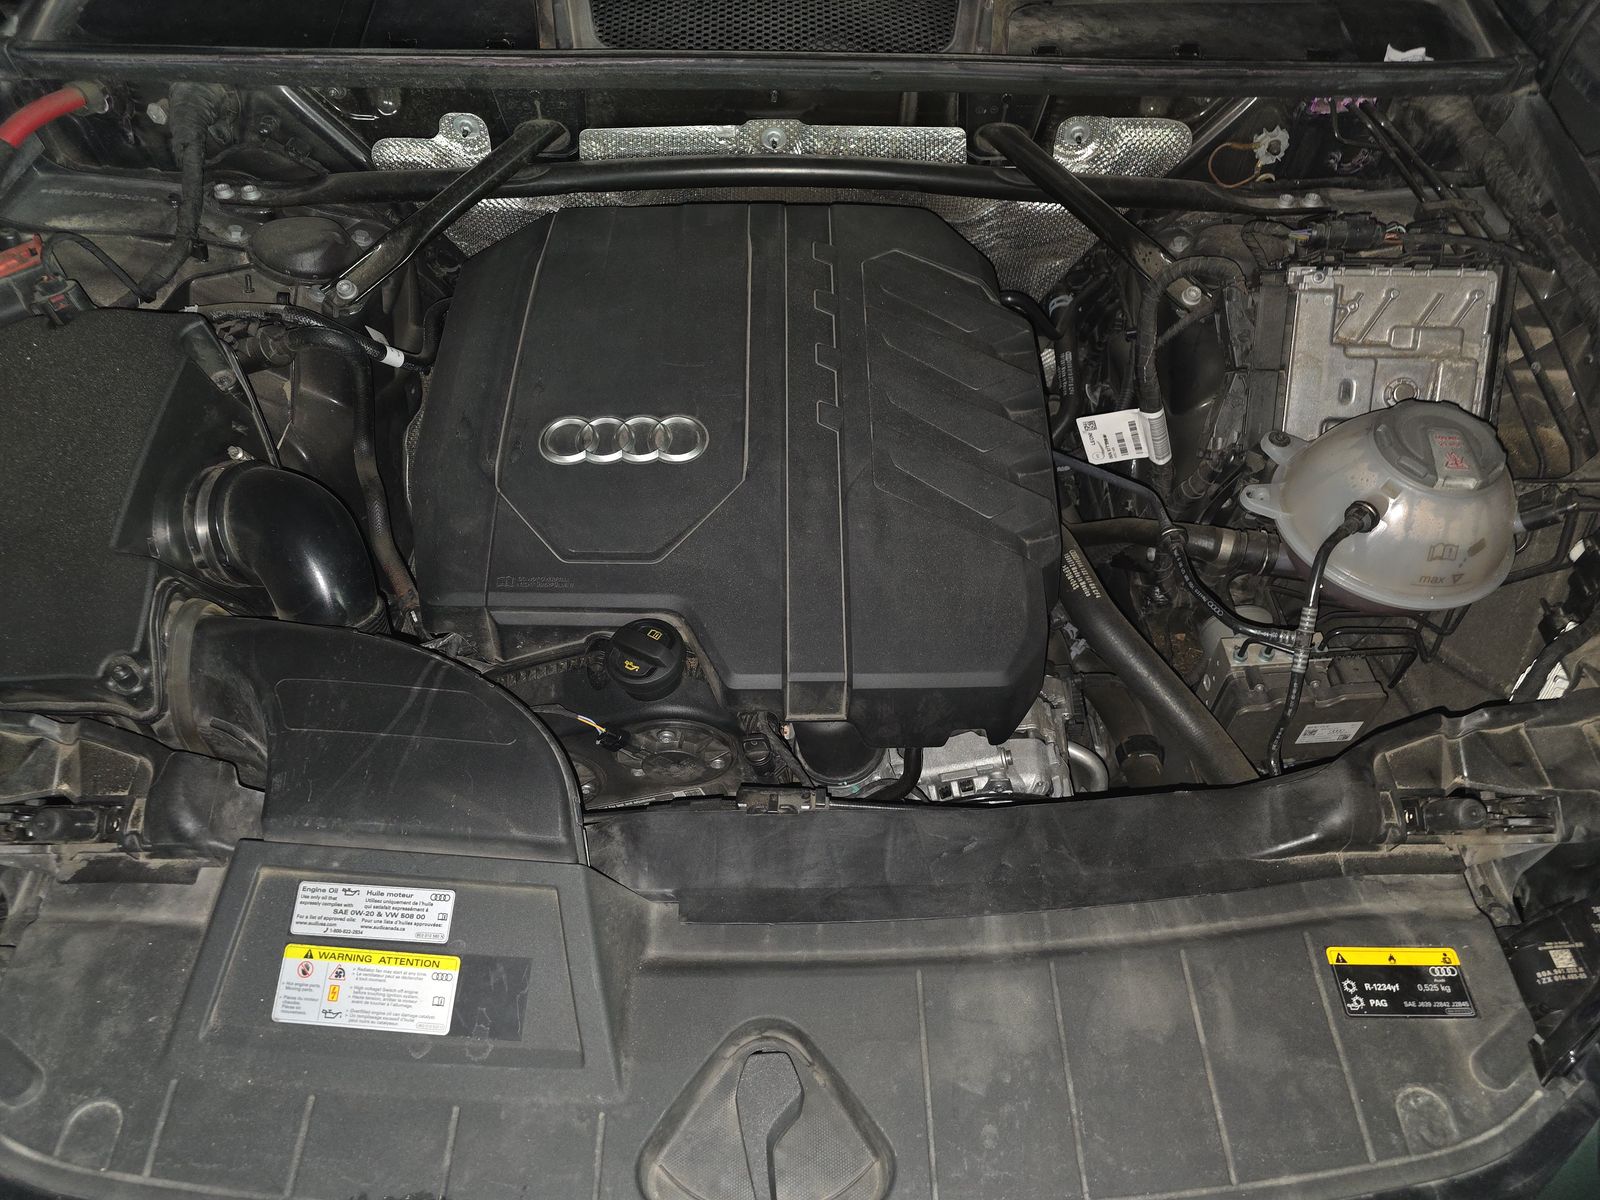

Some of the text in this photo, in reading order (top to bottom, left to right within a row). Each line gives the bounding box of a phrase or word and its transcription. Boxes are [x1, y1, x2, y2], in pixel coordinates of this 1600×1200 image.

[1419, 576, 1446, 584] max
[318, 952, 440, 968] WARNING ATTENTION
[1364, 983, 1451, 993] R-1234yf 0,525 kg
